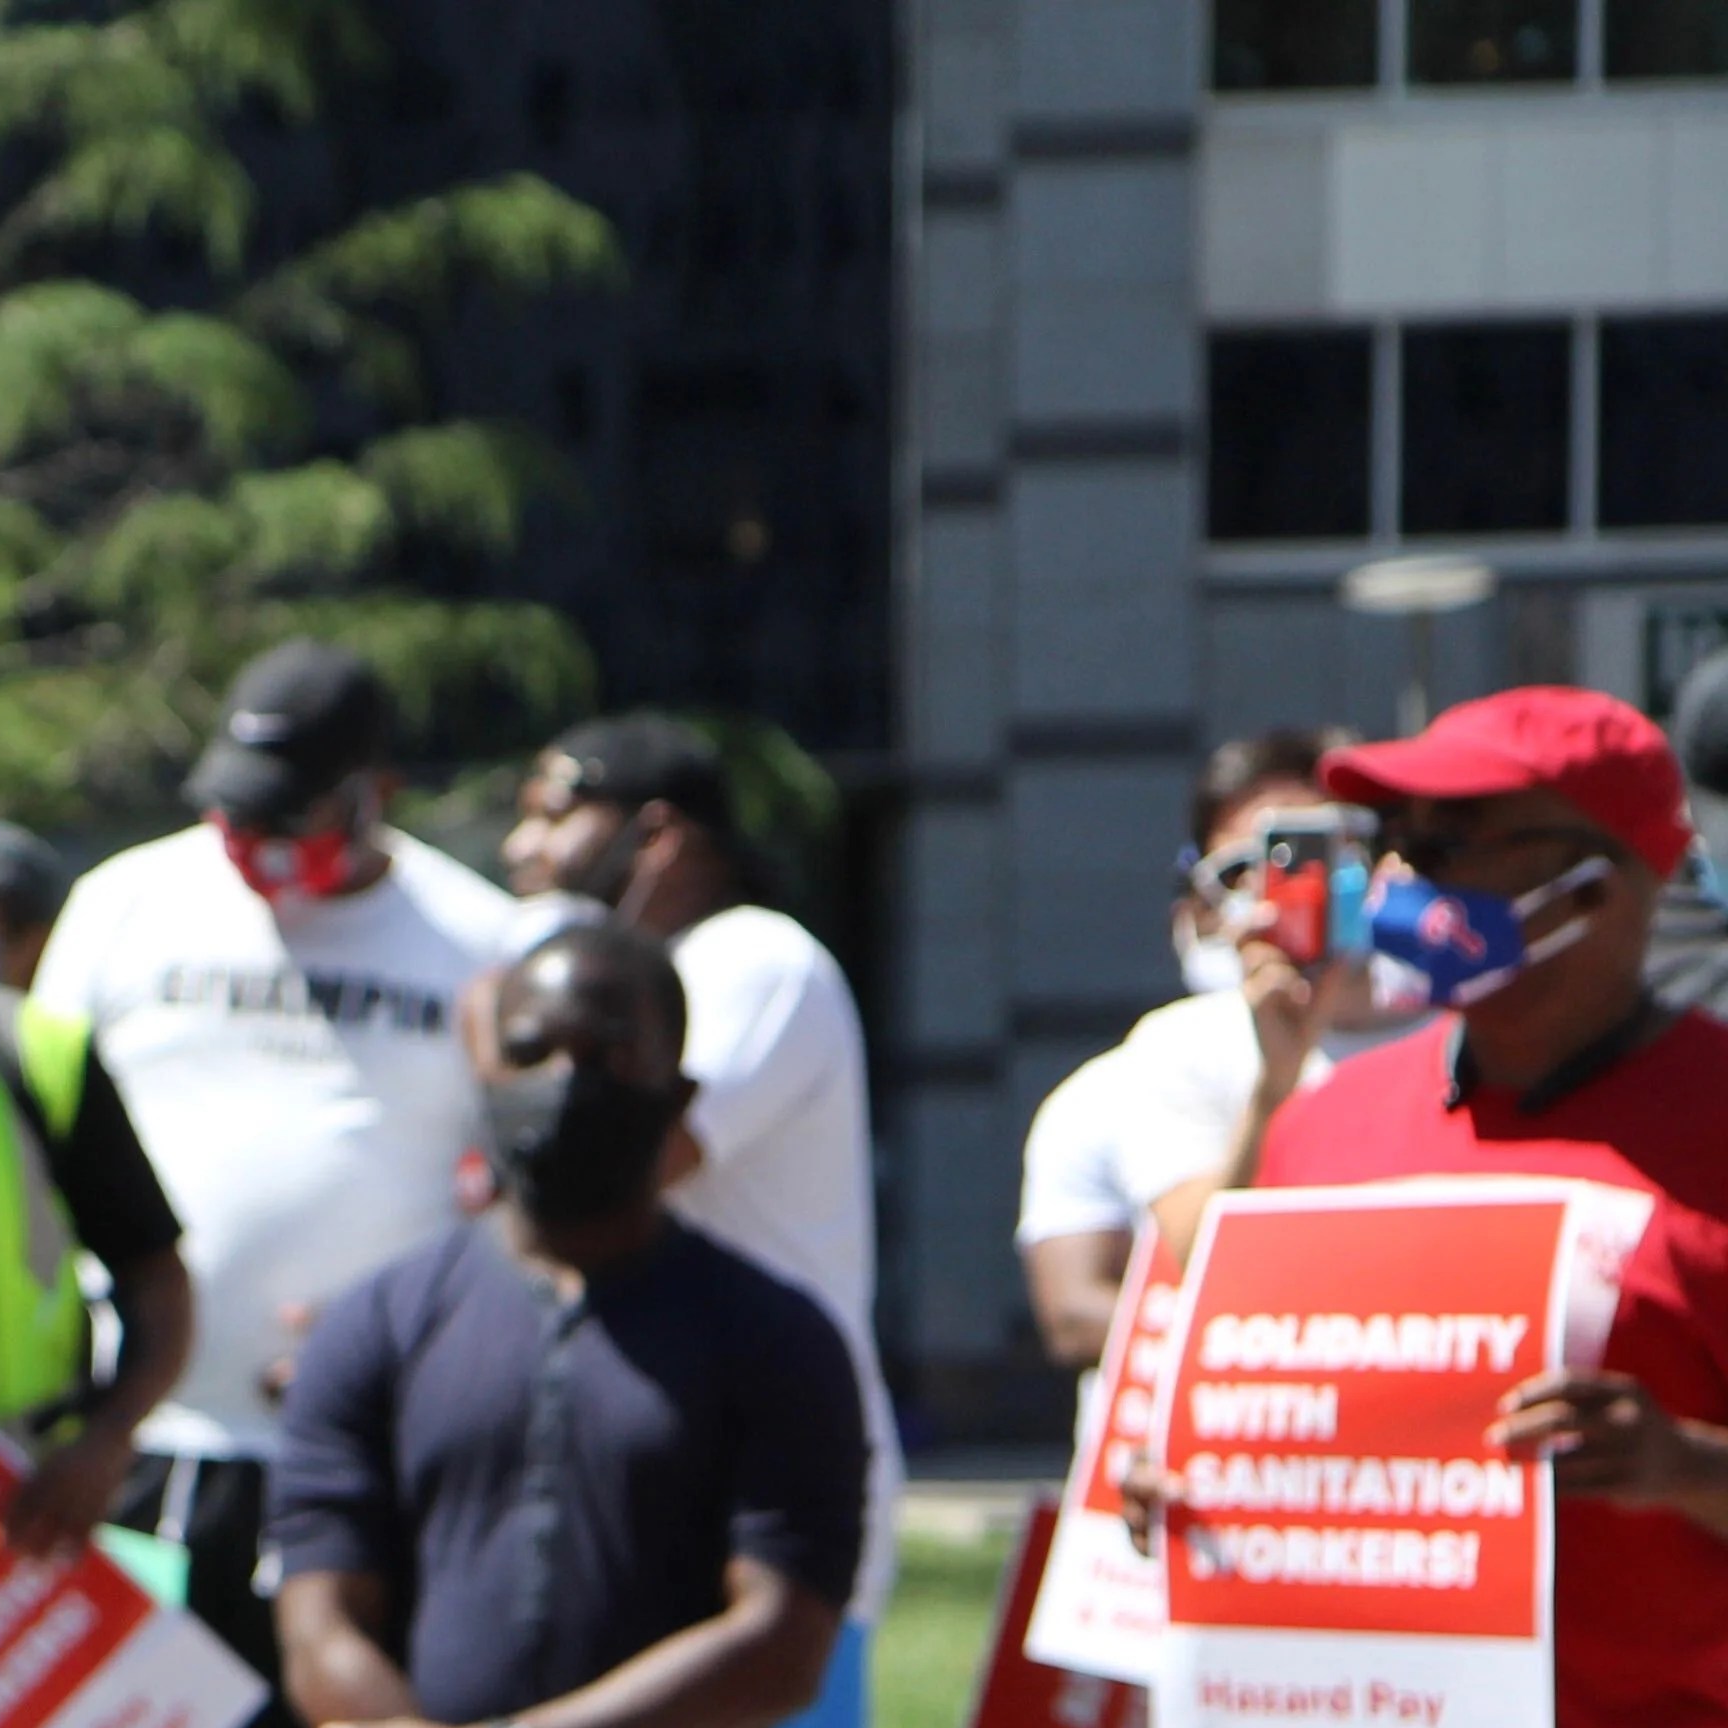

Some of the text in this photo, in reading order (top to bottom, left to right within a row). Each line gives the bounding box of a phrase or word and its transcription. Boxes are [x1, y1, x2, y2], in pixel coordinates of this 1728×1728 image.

[1199, 1312, 1529, 1374] SOLIDARITY
[1188, 1381, 1339, 1442] WITH
[1184, 1452, 1525, 1518] SANITATION
[1199, 1675, 1352, 1722] Hazard
